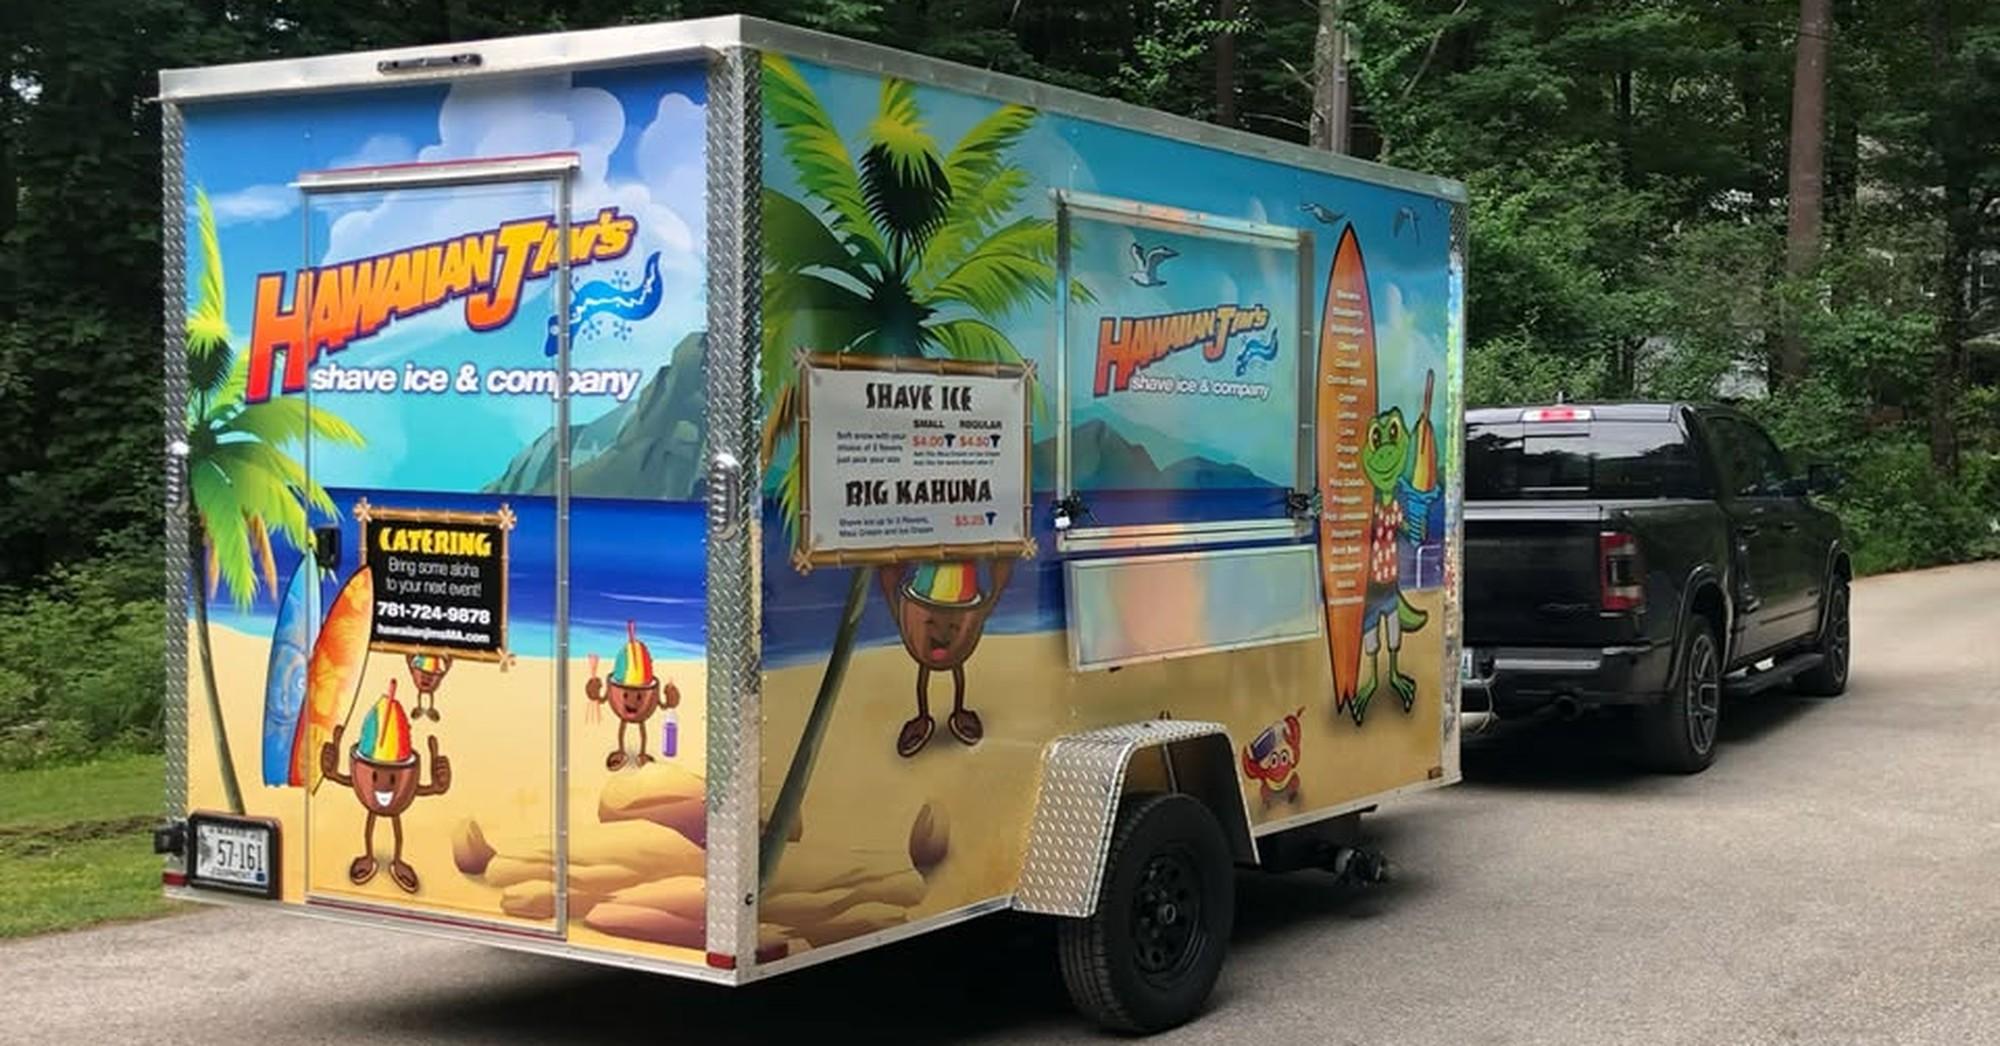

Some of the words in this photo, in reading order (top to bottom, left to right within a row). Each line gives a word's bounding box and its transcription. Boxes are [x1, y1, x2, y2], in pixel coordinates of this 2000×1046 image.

[245, 232, 497, 404] HAWAIIAN
[1093, 308, 1216, 398] HAWAIIAN
[309, 362, 398, 394] shave
[402, 362, 450, 394] ice
[455, 363, 479, 394] &
[486, 368, 640, 401] company
[1131, 374, 1176, 392] shave
[1176, 379, 1196, 393] ice
[1199, 379, 1209, 393] &
[1212, 382, 1270, 400] company
[866, 383, 933, 411] SHAVE
[942, 386, 972, 412] ICE
[913, 420, 944, 429] SMALL
[959, 420, 1002, 430] REGULAR
[912, 435, 944, 447] $4.00
[846, 480, 888, 507] BIG
[896, 479, 993, 505] KAHUNA
[378, 527, 492, 557] CATERING
[388, 556, 416, 577] Bring
[418, 561, 448, 576] some
[449, 561, 480, 578] aloha
[386, 577, 398, 591] to
[398, 580, 422, 594] your
[423, 581, 447, 594] next
[376, 601, 491, 625] 781-724-9878
[217, 839, 262, 871] 57-161
